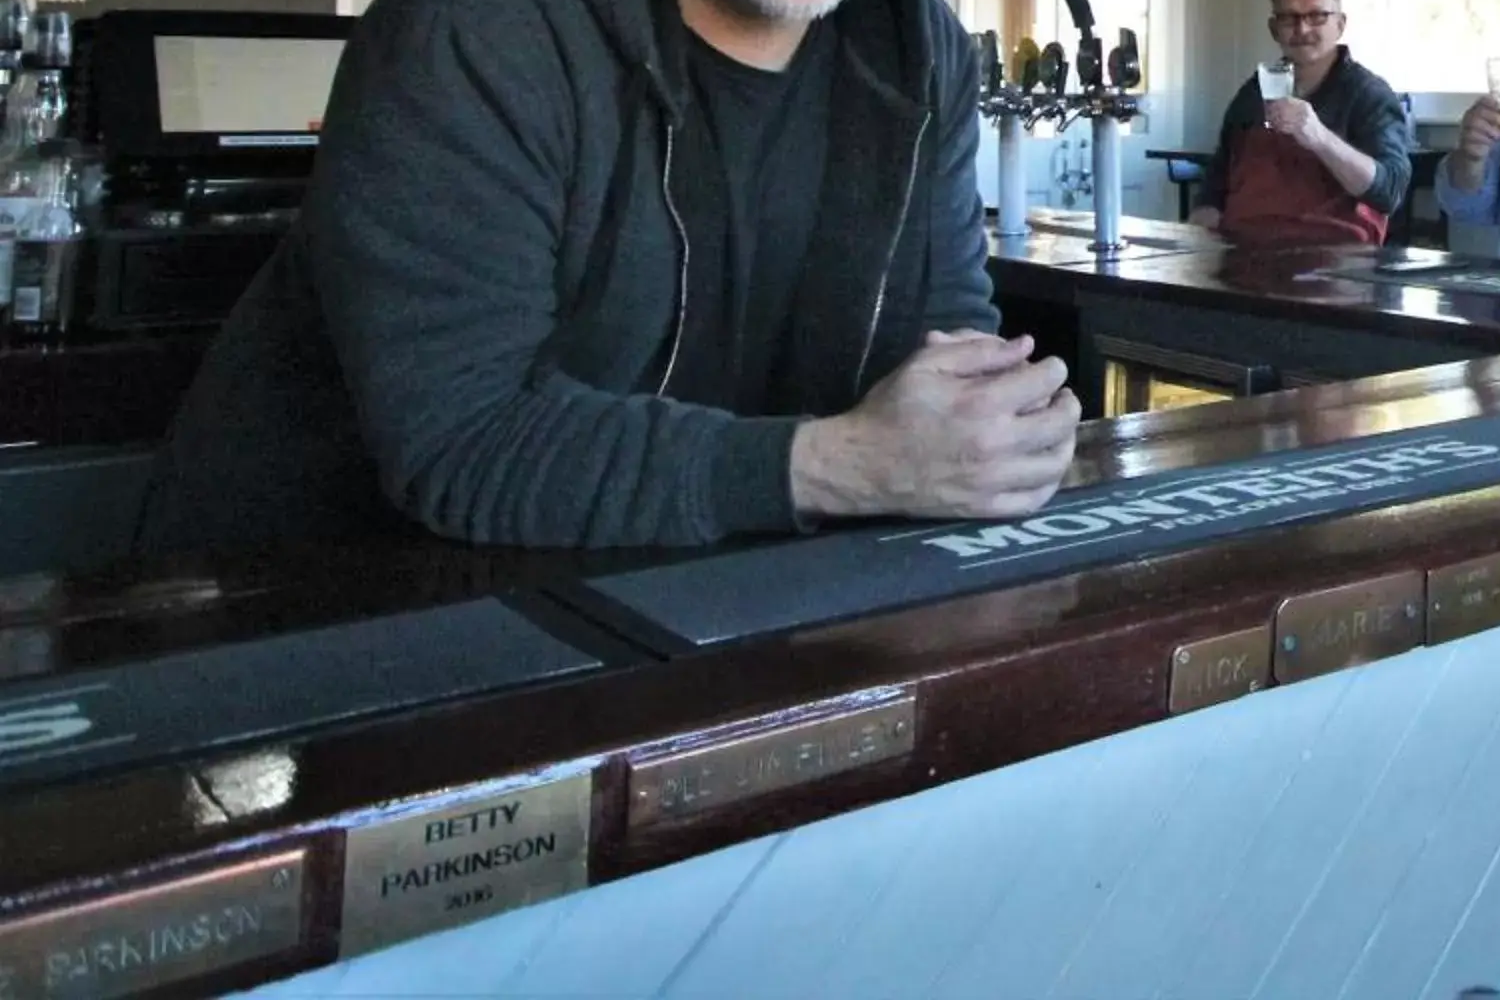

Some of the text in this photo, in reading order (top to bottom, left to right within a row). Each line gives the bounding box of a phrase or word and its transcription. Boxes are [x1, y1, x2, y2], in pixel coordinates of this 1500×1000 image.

[920, 441, 1499, 560] MONTEITH'S
[424, 800, 523, 846] BETTY
[380, 832, 556, 898] PARKINSON
[45, 903, 264, 990] PARKINSON
